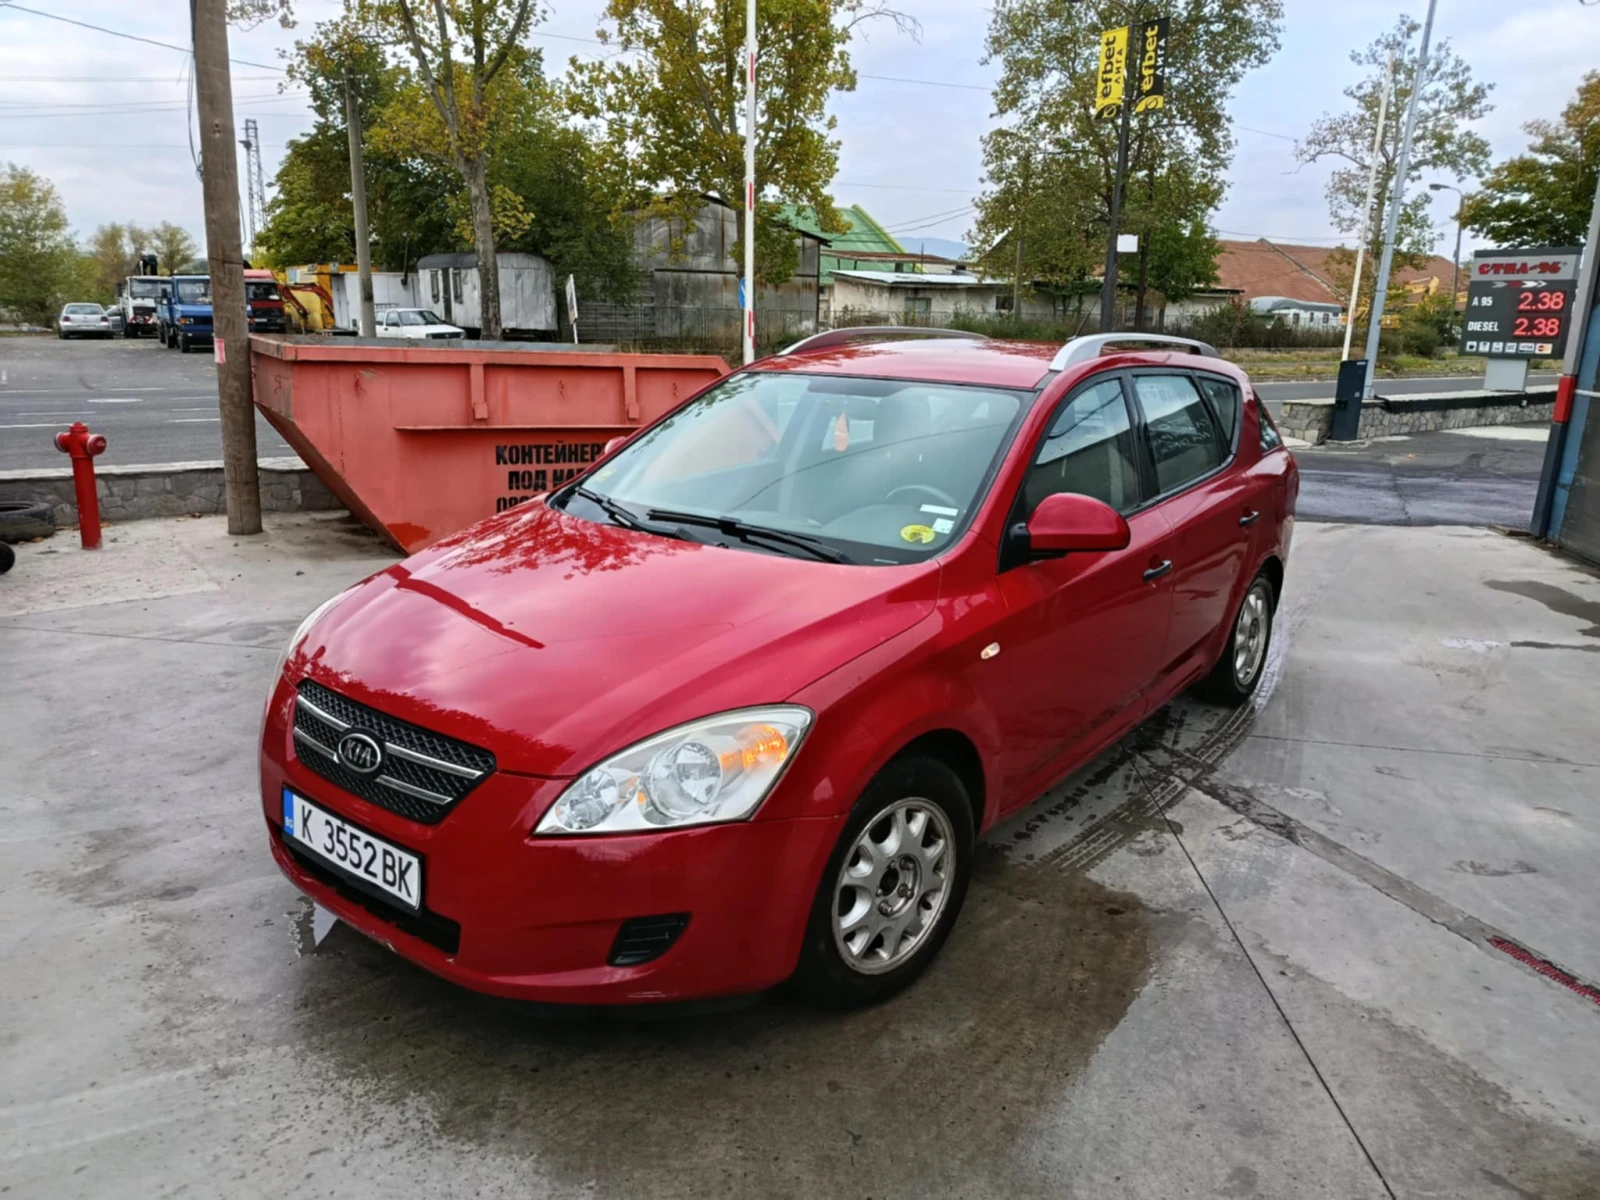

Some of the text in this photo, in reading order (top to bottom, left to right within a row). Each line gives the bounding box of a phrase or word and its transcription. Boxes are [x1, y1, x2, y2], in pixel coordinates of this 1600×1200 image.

[1101, 35, 1116, 98] efbet
[1141, 25, 1158, 92] efbet
[1518, 292, 1565, 310] 2.38
[1467, 321, 1499, 332] DIESEL
[1513, 318, 1559, 336] 2.38
[495, 440, 605, 465] КОНТЕЙНЕР
[508, 468, 586, 491] ПОД НА
[344, 738, 372, 767] KIA
[301, 805, 313, 843] K
